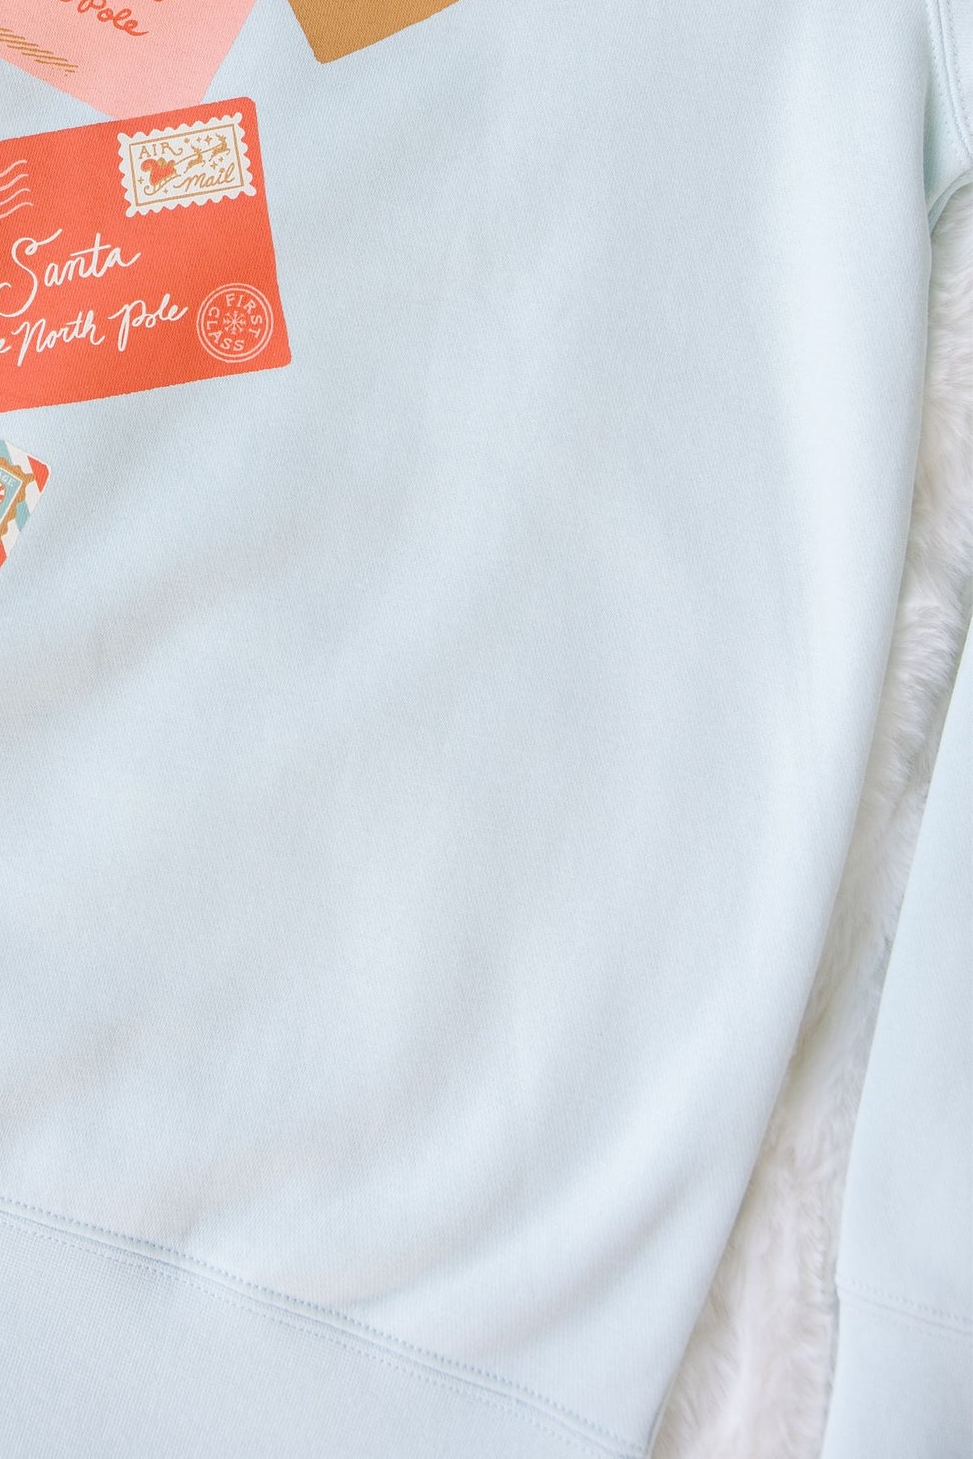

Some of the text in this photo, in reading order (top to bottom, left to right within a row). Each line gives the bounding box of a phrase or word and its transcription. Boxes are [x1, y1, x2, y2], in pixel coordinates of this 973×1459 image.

[138, 141, 182, 159] AIR
[13, 308, 105, 367] North
[108, 293, 188, 352] Pole
[207, 307, 245, 351] CLASS
[226, 293, 263, 338] FIRST
